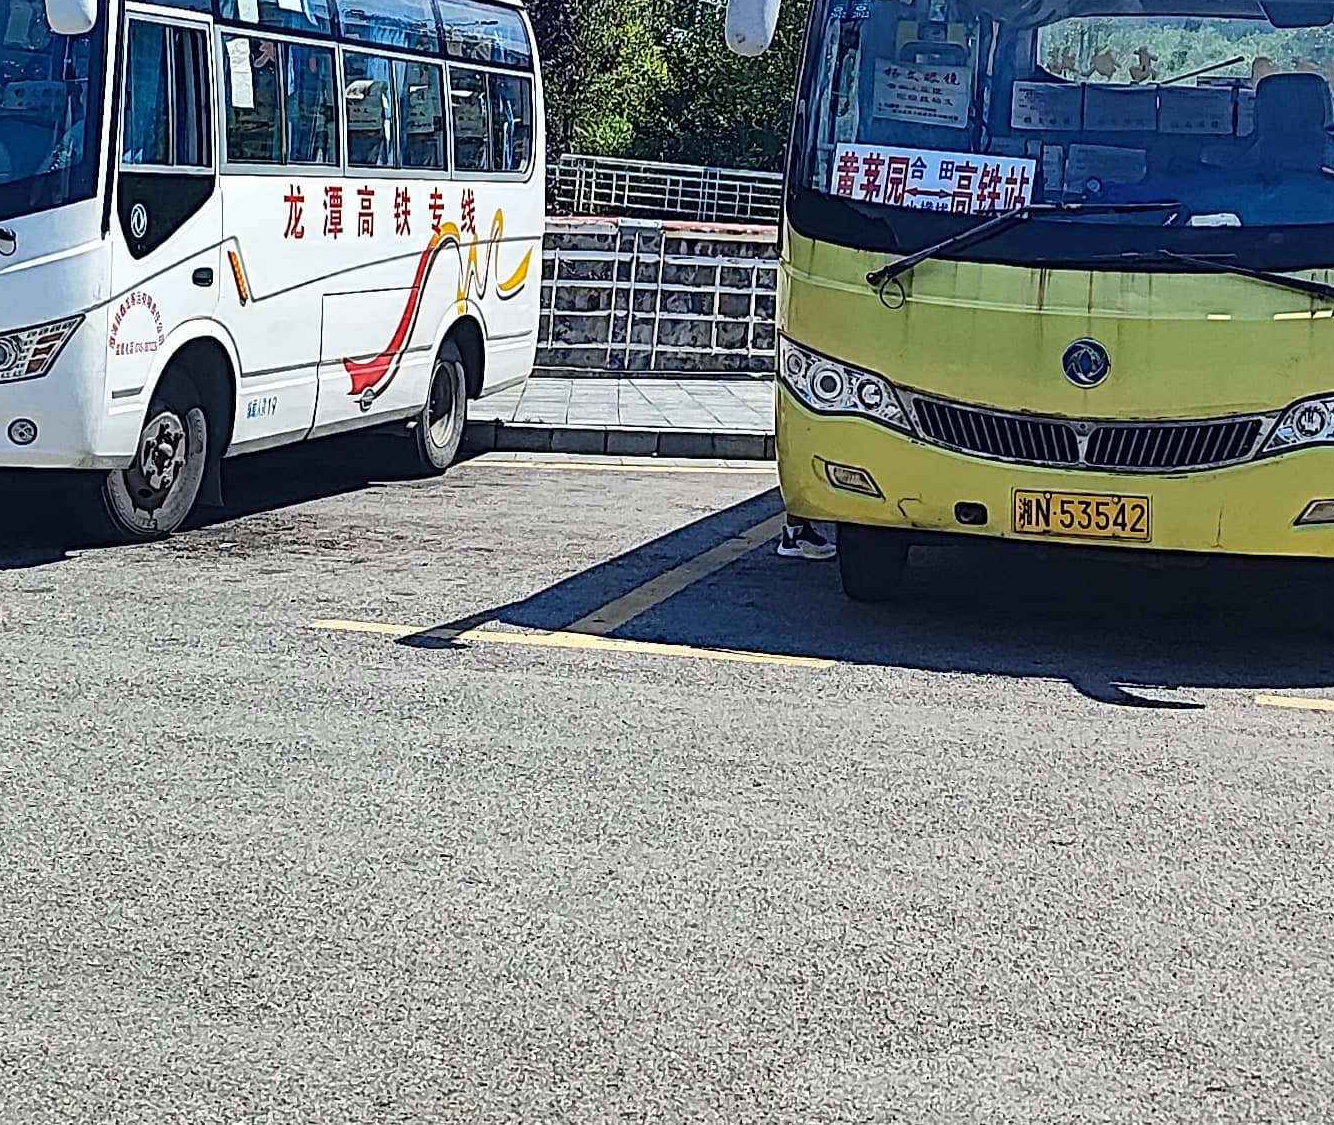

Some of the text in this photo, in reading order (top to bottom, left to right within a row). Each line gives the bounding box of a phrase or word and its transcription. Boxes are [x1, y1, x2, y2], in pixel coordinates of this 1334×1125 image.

[283, 184, 476, 239] 龙潭高铁专线
[837, 151, 1030, 217] 黄茅园 合田 高铁站
